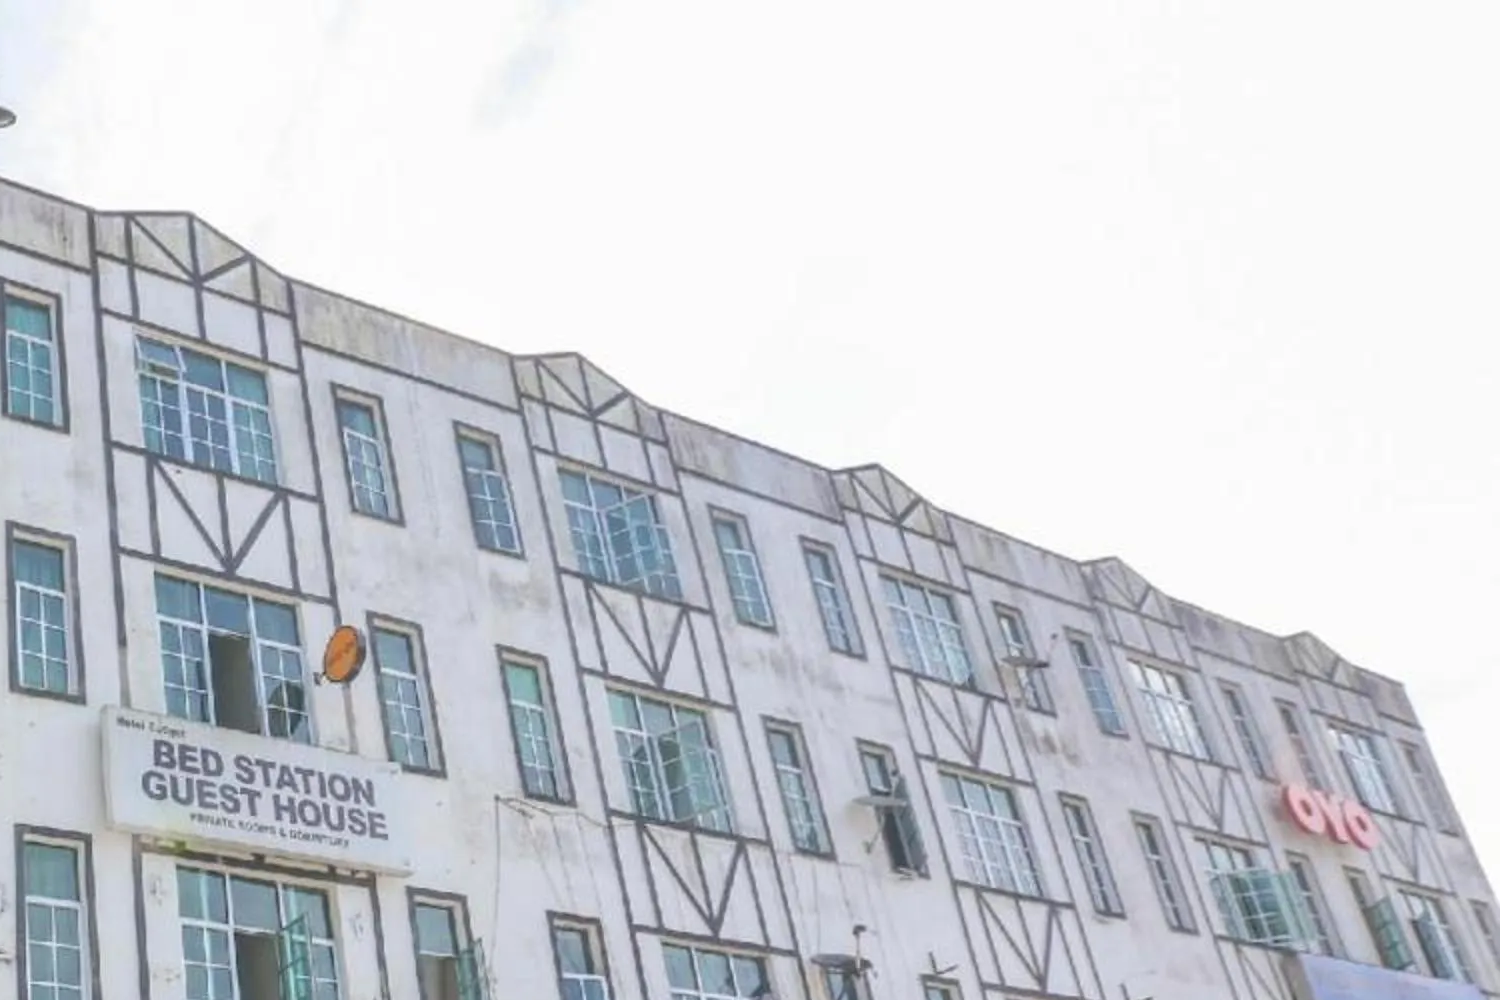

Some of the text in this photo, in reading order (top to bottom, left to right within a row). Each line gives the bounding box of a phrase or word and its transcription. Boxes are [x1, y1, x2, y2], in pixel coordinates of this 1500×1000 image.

[141, 769, 389, 841] GUEST HOUSE
[153, 739, 375, 807] BED STATION
